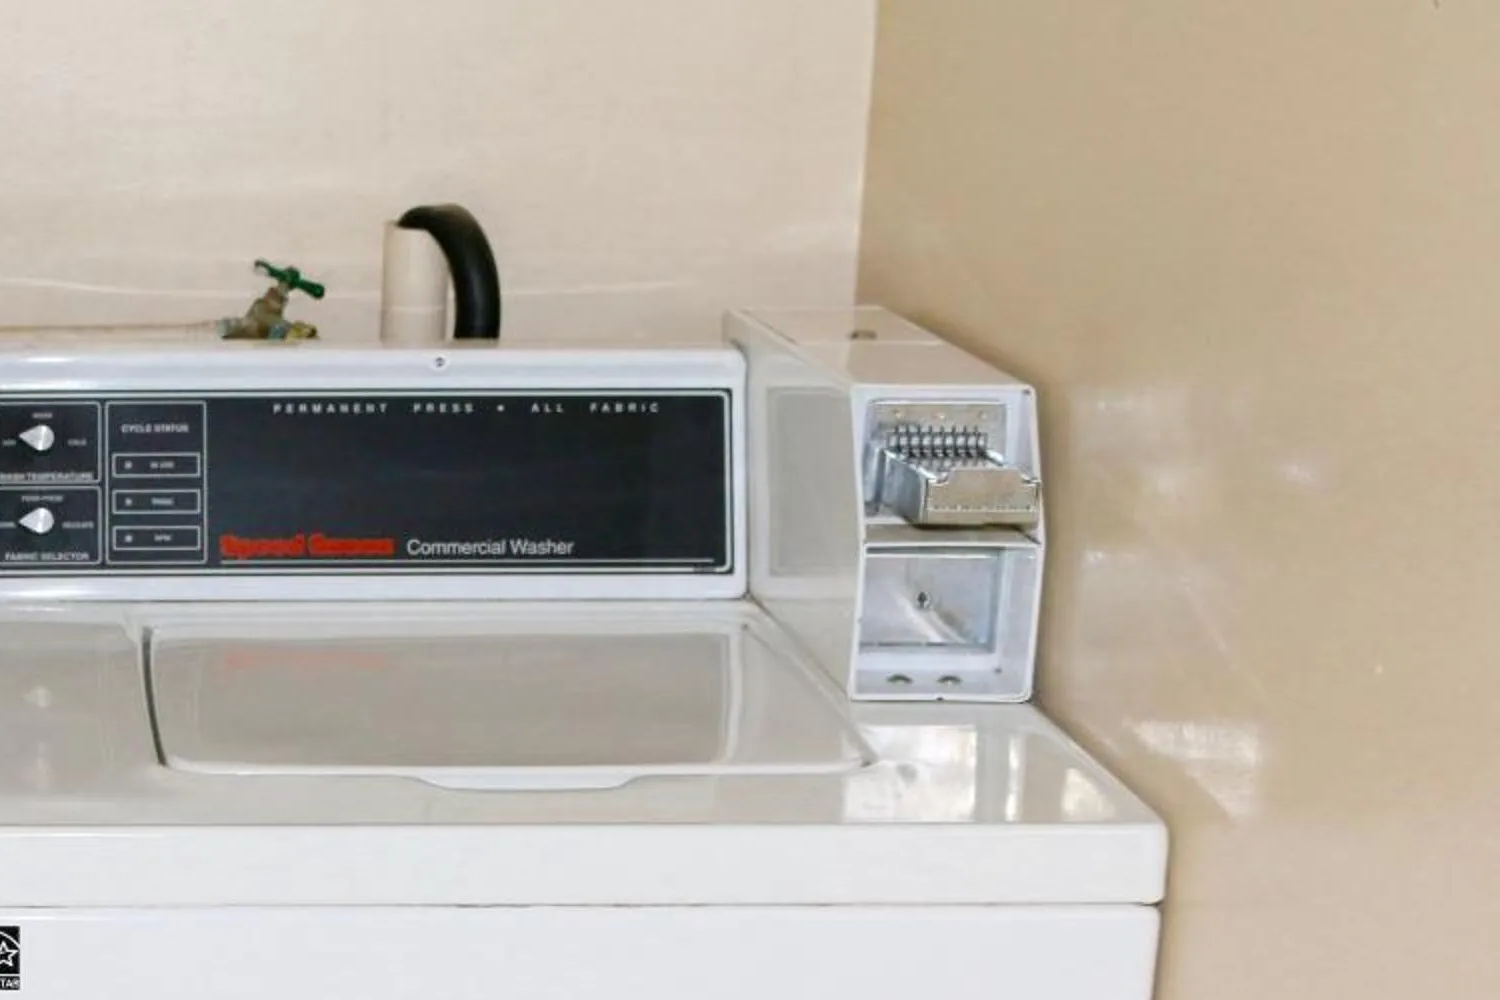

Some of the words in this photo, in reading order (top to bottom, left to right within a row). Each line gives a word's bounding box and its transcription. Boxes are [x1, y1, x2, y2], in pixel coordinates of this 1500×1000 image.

[273, 402, 389, 414] PERMANENT
[413, 402, 475, 414] PRESS
[531, 402, 566, 414] ALL
[589, 402, 661, 414] FABRIC
[120, 423, 152, 433] CYCLE
[406, 537, 508, 555] Commercial
[510, 538, 576, 556] Washer
